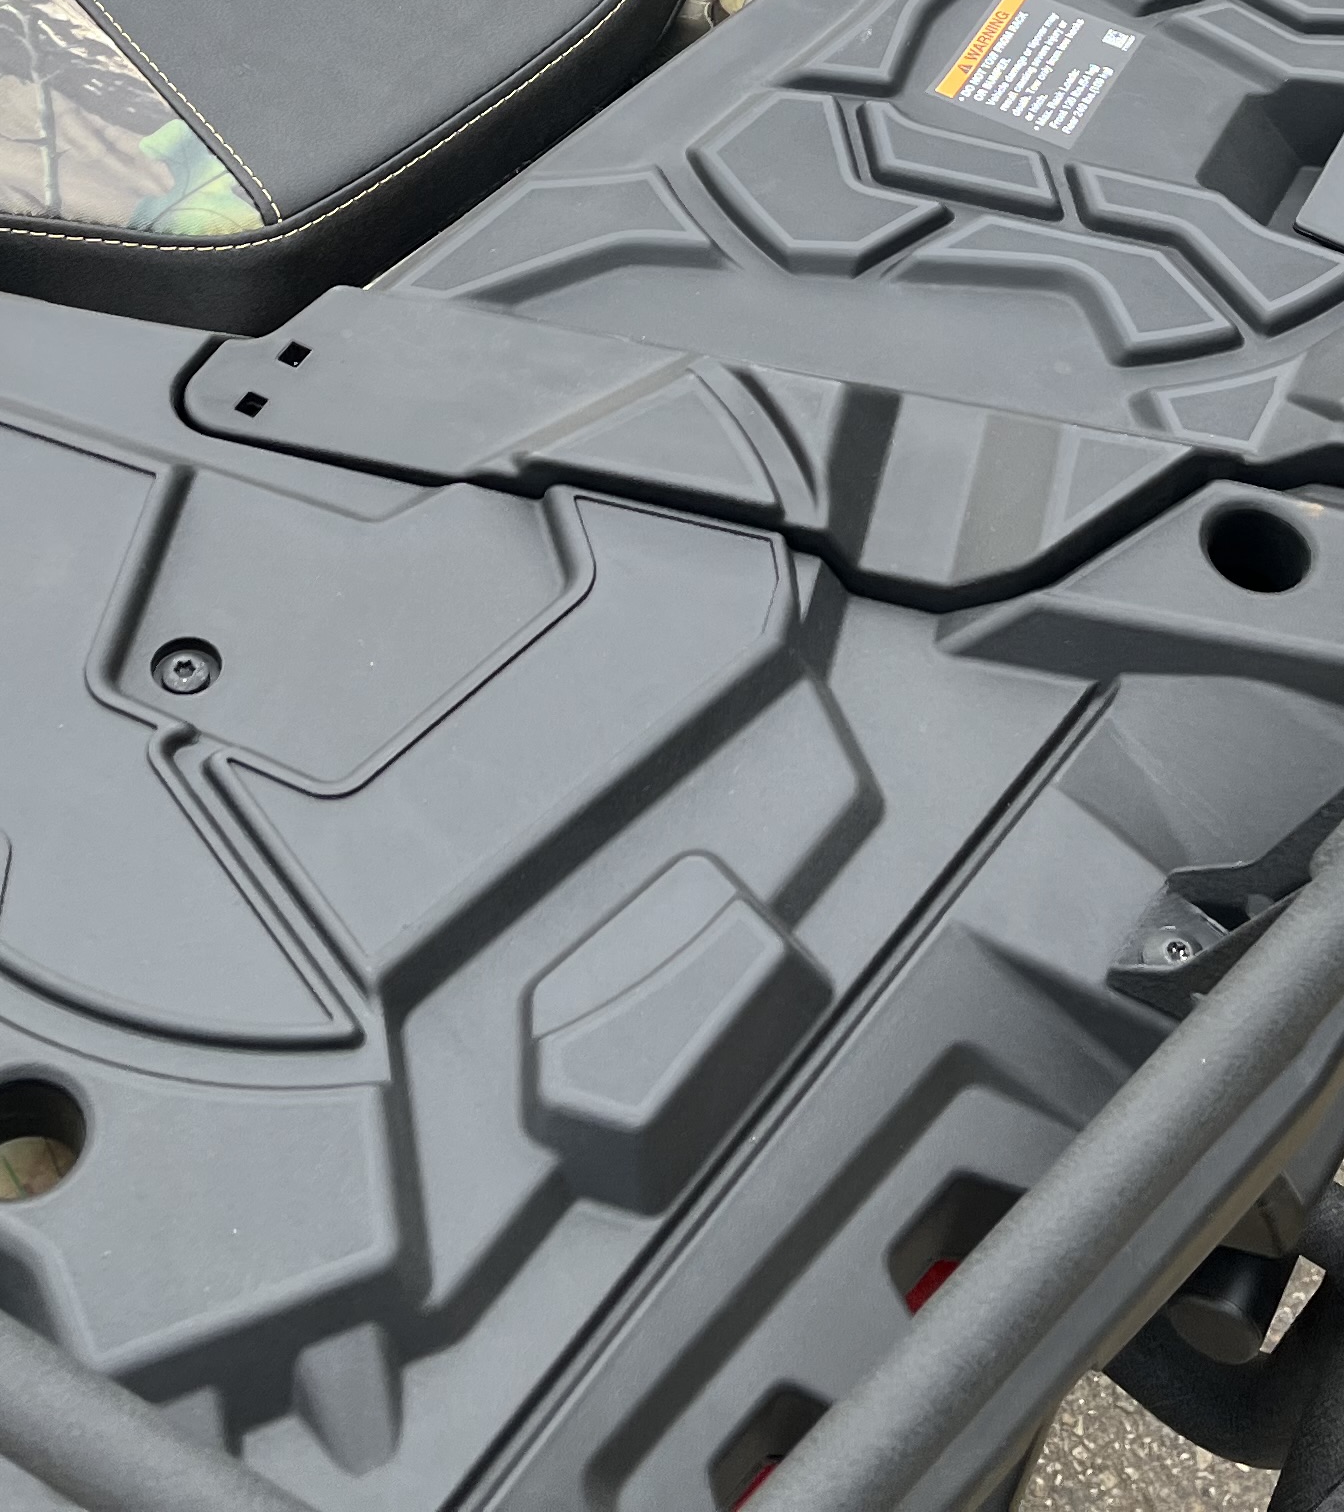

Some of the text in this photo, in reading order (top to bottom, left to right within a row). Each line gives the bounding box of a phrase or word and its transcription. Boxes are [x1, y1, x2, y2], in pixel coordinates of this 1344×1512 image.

[960, 11, 1029, 97] DO NOT TOW FROM RACK
[964, 10, 1009, 62] WARNING
[973, 89, 988, 101] OR
